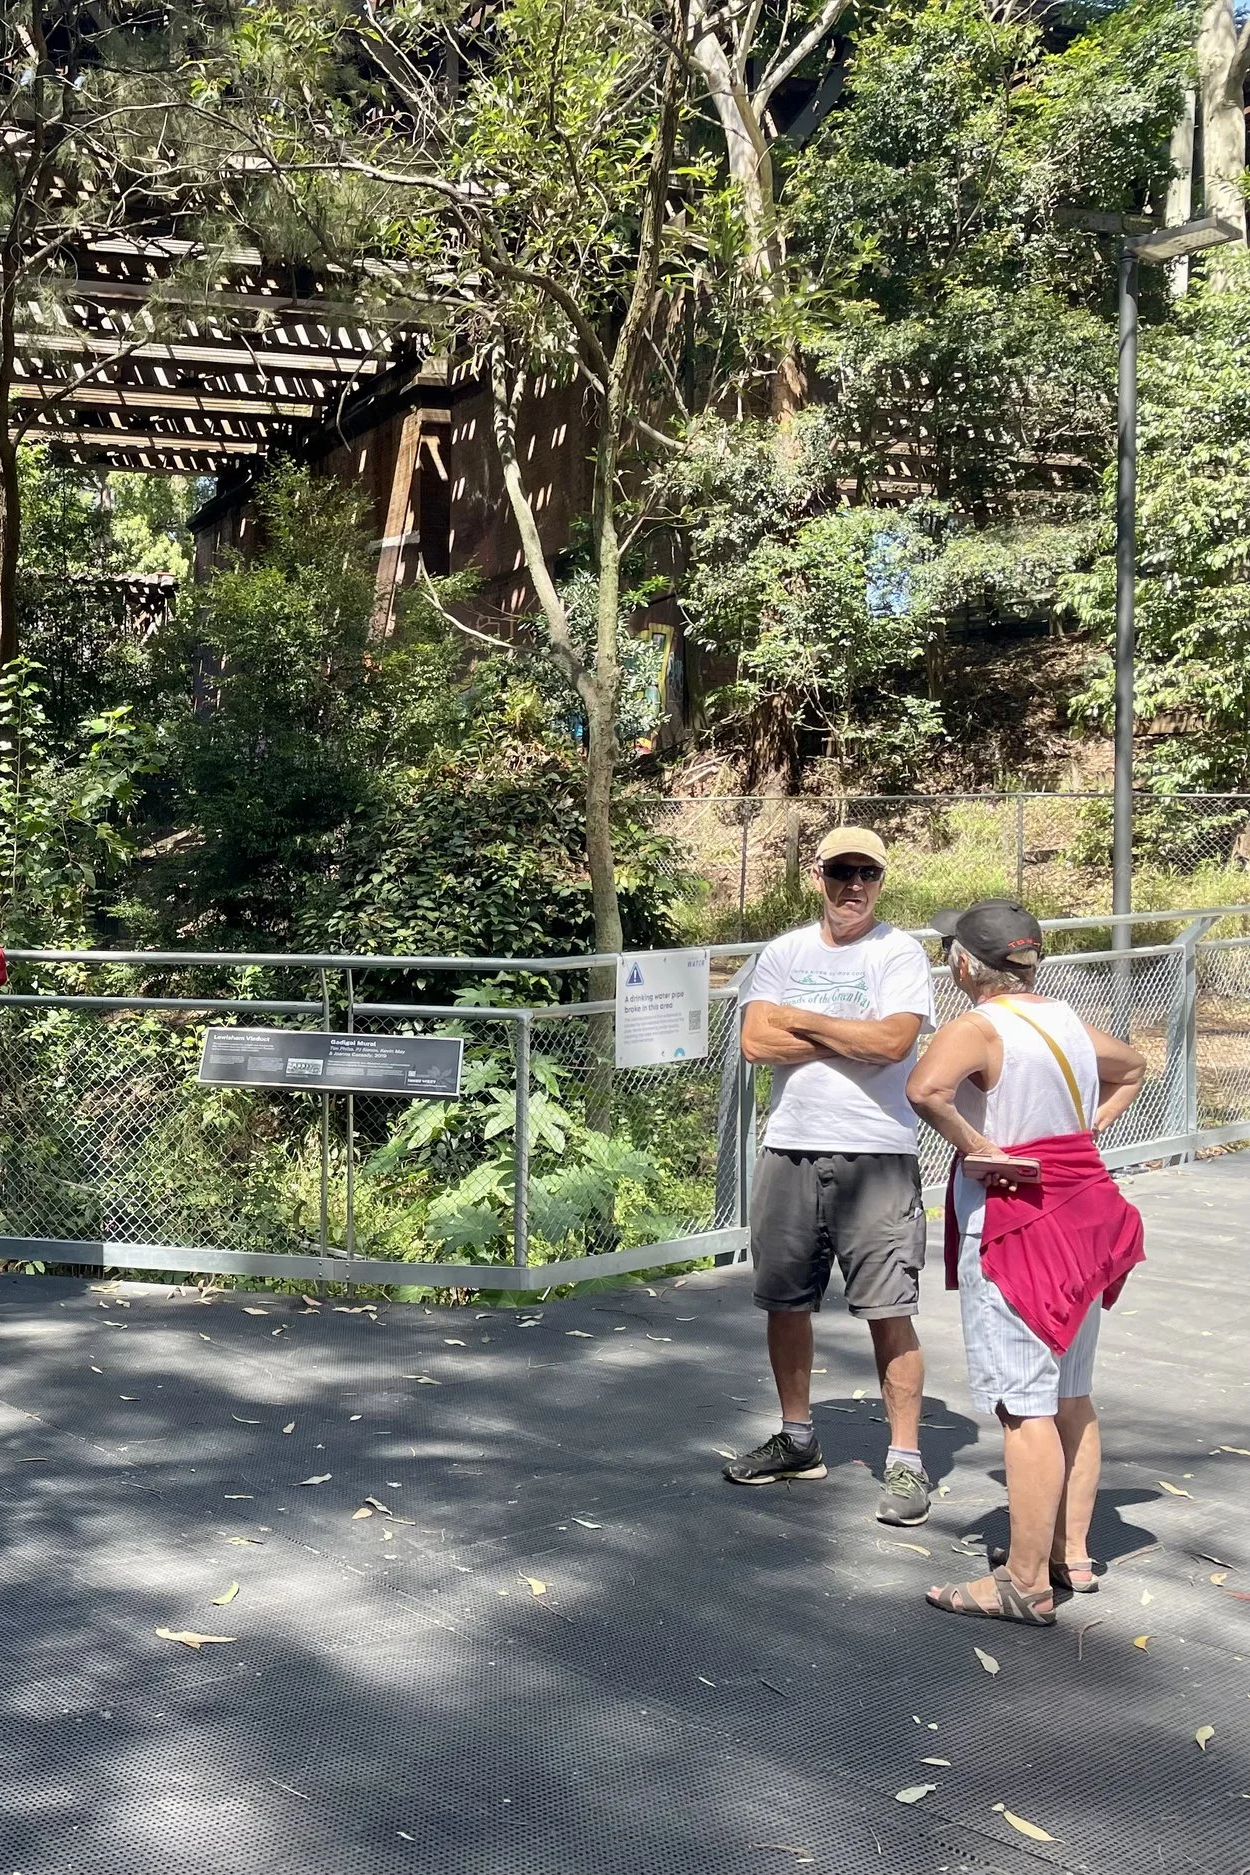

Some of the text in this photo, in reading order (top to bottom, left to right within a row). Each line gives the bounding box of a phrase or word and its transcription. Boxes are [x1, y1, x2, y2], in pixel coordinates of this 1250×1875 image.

[630, 994, 653, 1002] drinking
[671, 991, 684, 999] pipe
[808, 993, 819, 1003] of
[819, 993, 830, 1003] the
[624, 1004, 641, 1013] broke
[648, 1003, 659, 1011] this
